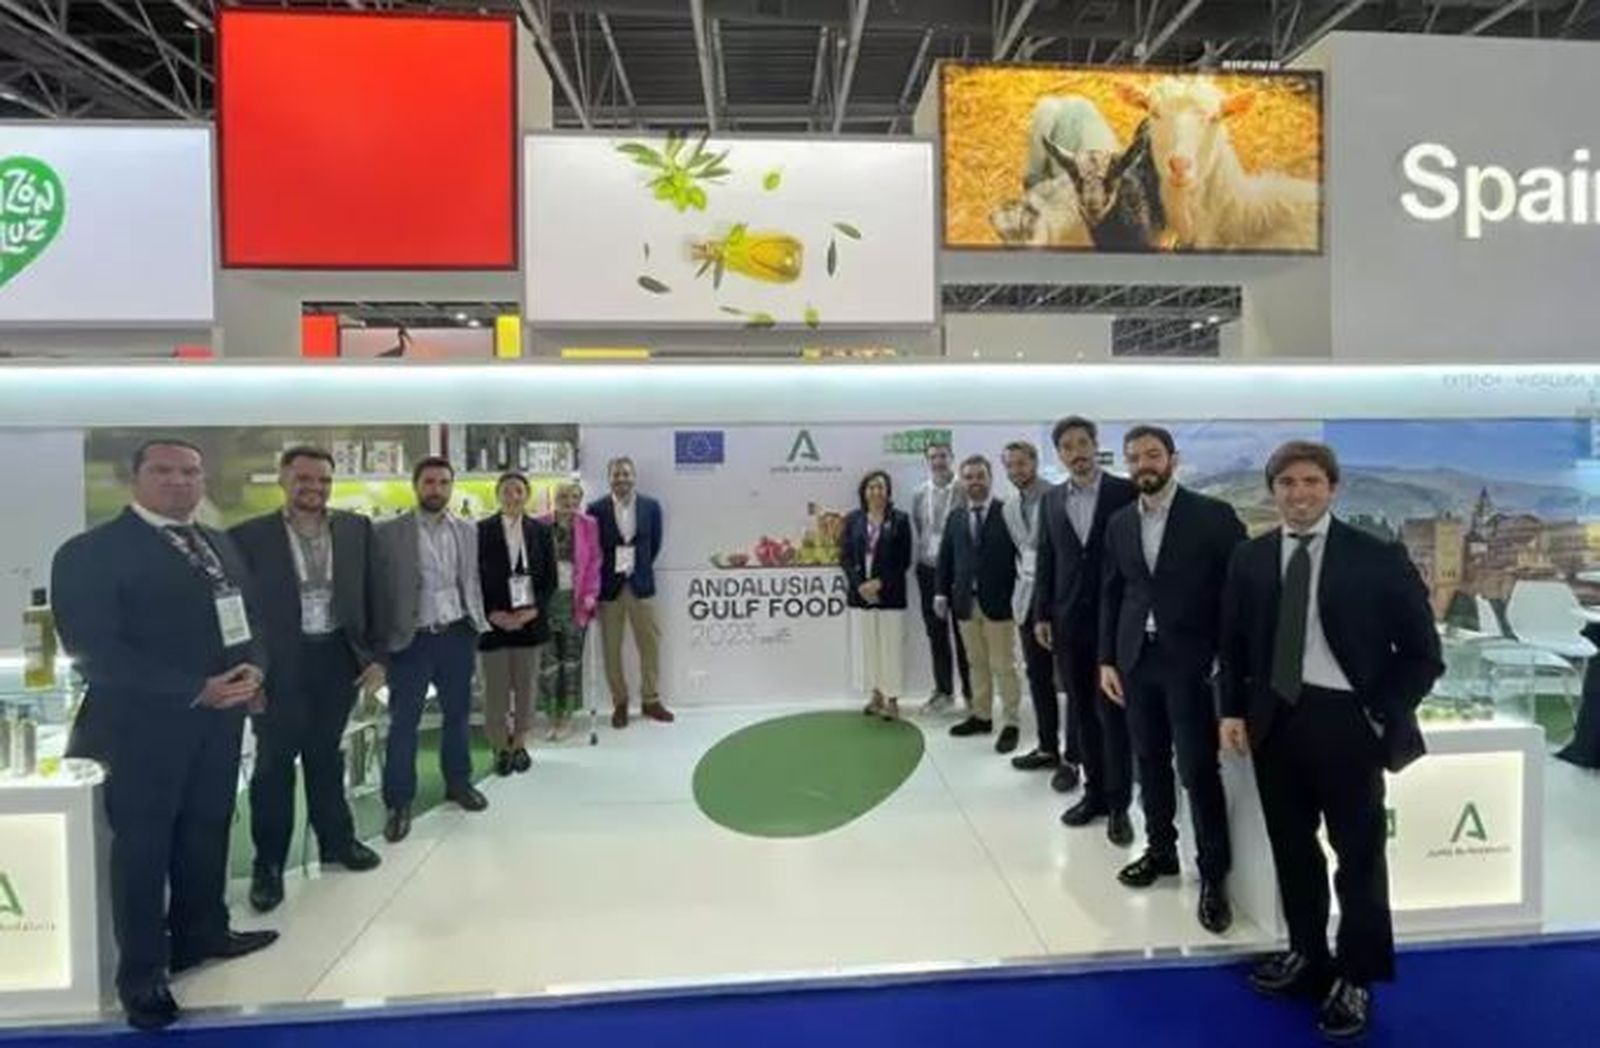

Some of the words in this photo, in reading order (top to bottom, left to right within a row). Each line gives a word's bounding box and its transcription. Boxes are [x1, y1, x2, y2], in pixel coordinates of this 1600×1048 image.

[0, 169, 55, 215] ZÓN
[688, 576, 826, 598] ANDALUSIA
[688, 600, 760, 620] GULF
[768, 597, 845, 619] FOOD
